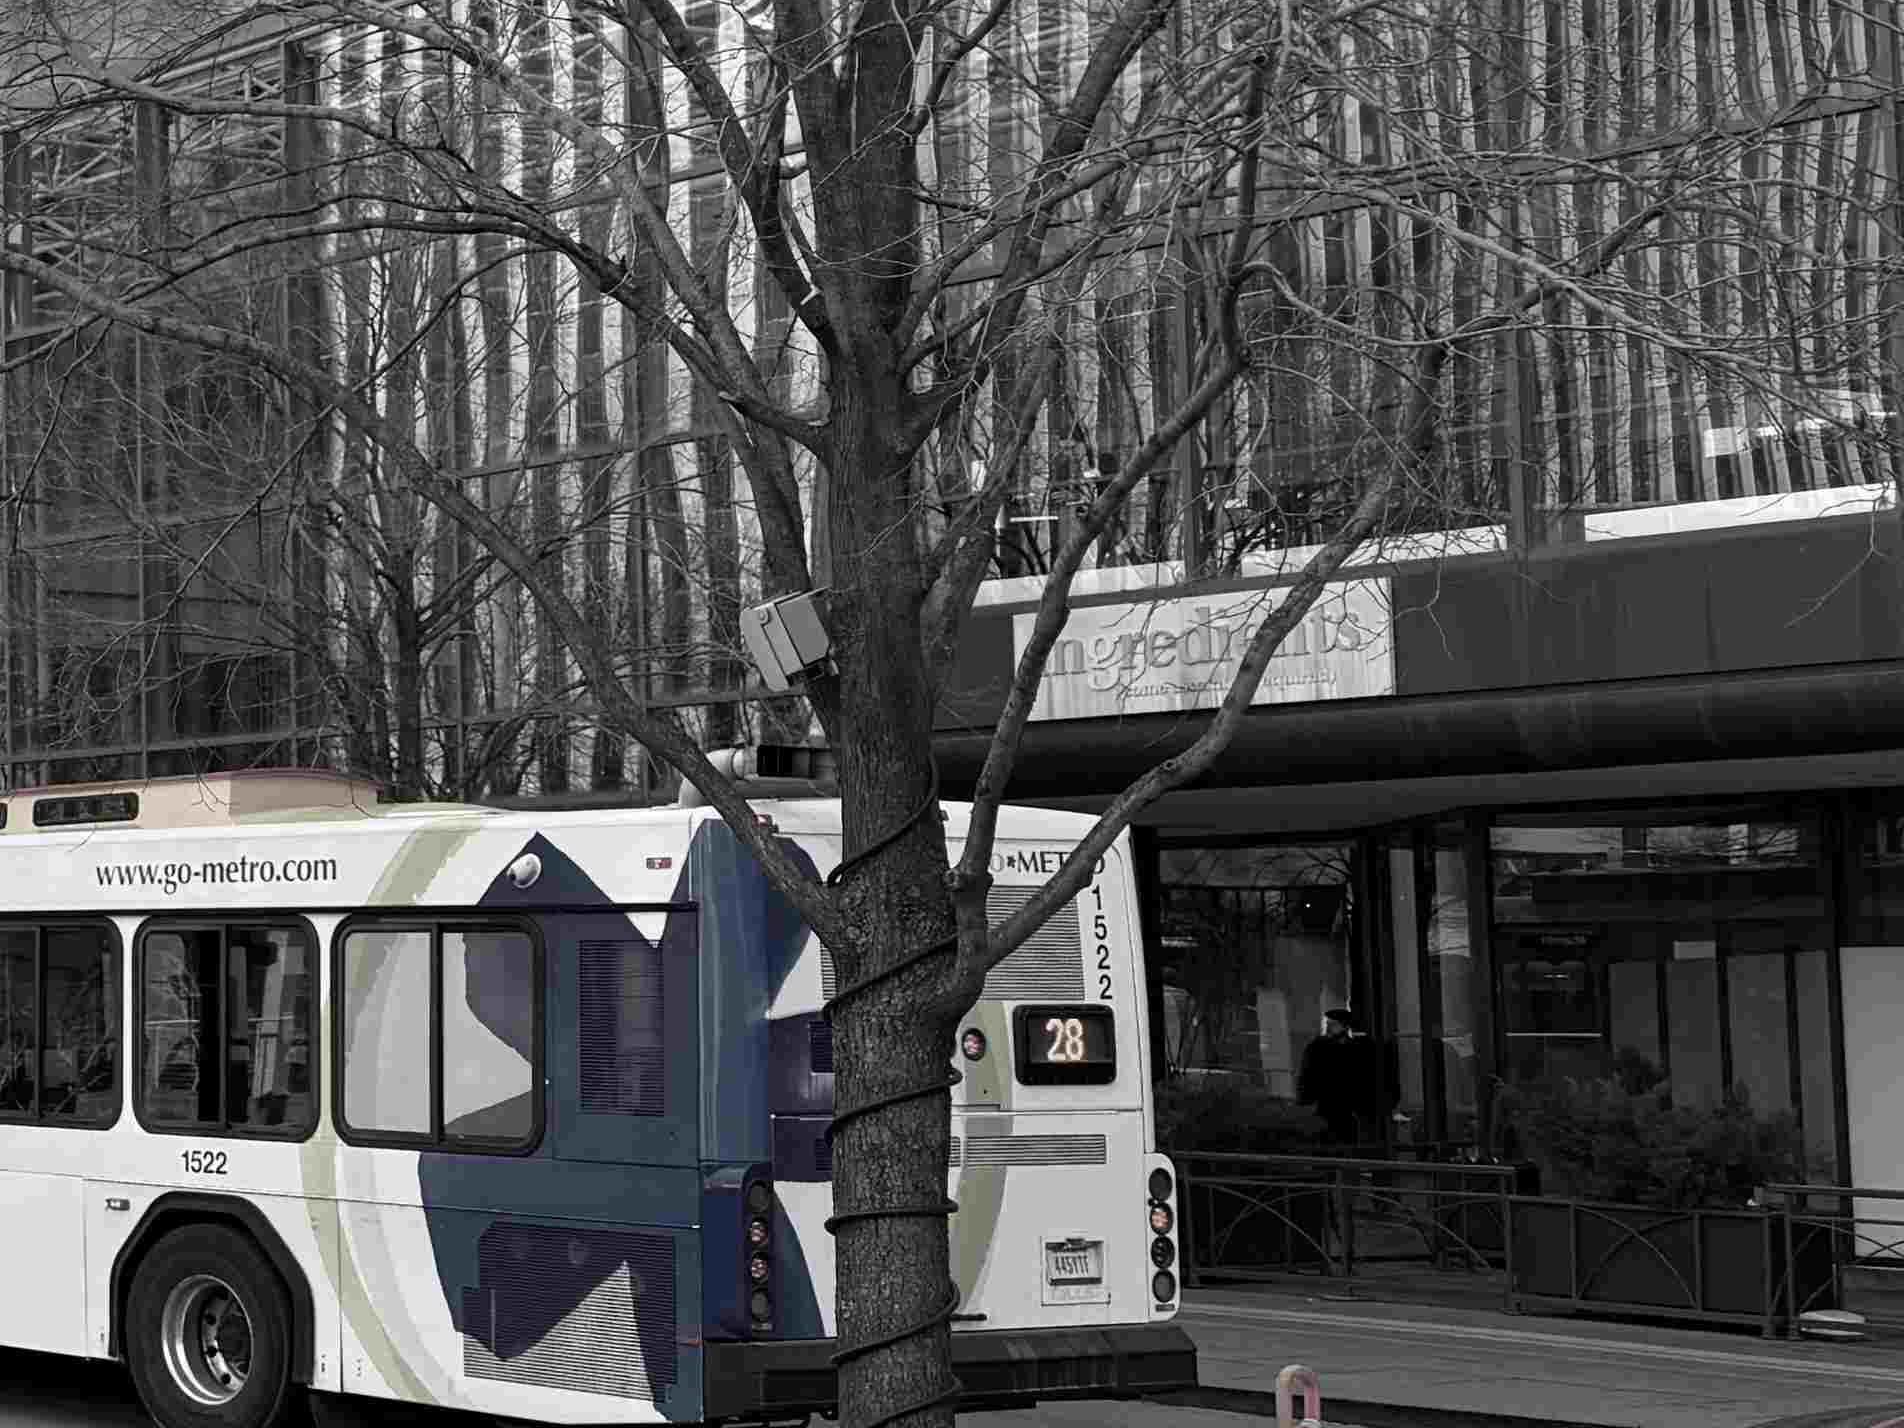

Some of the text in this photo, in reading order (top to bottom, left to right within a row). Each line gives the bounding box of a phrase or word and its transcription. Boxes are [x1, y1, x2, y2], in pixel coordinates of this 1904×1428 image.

[1040, 602, 1361, 691] ngredients
[96, 855, 337, 895] www.go-metro.com
[1018, 851, 1105, 874] METO
[1046, 1018, 1083, 1061] 28
[181, 1150, 227, 1174] 1522
